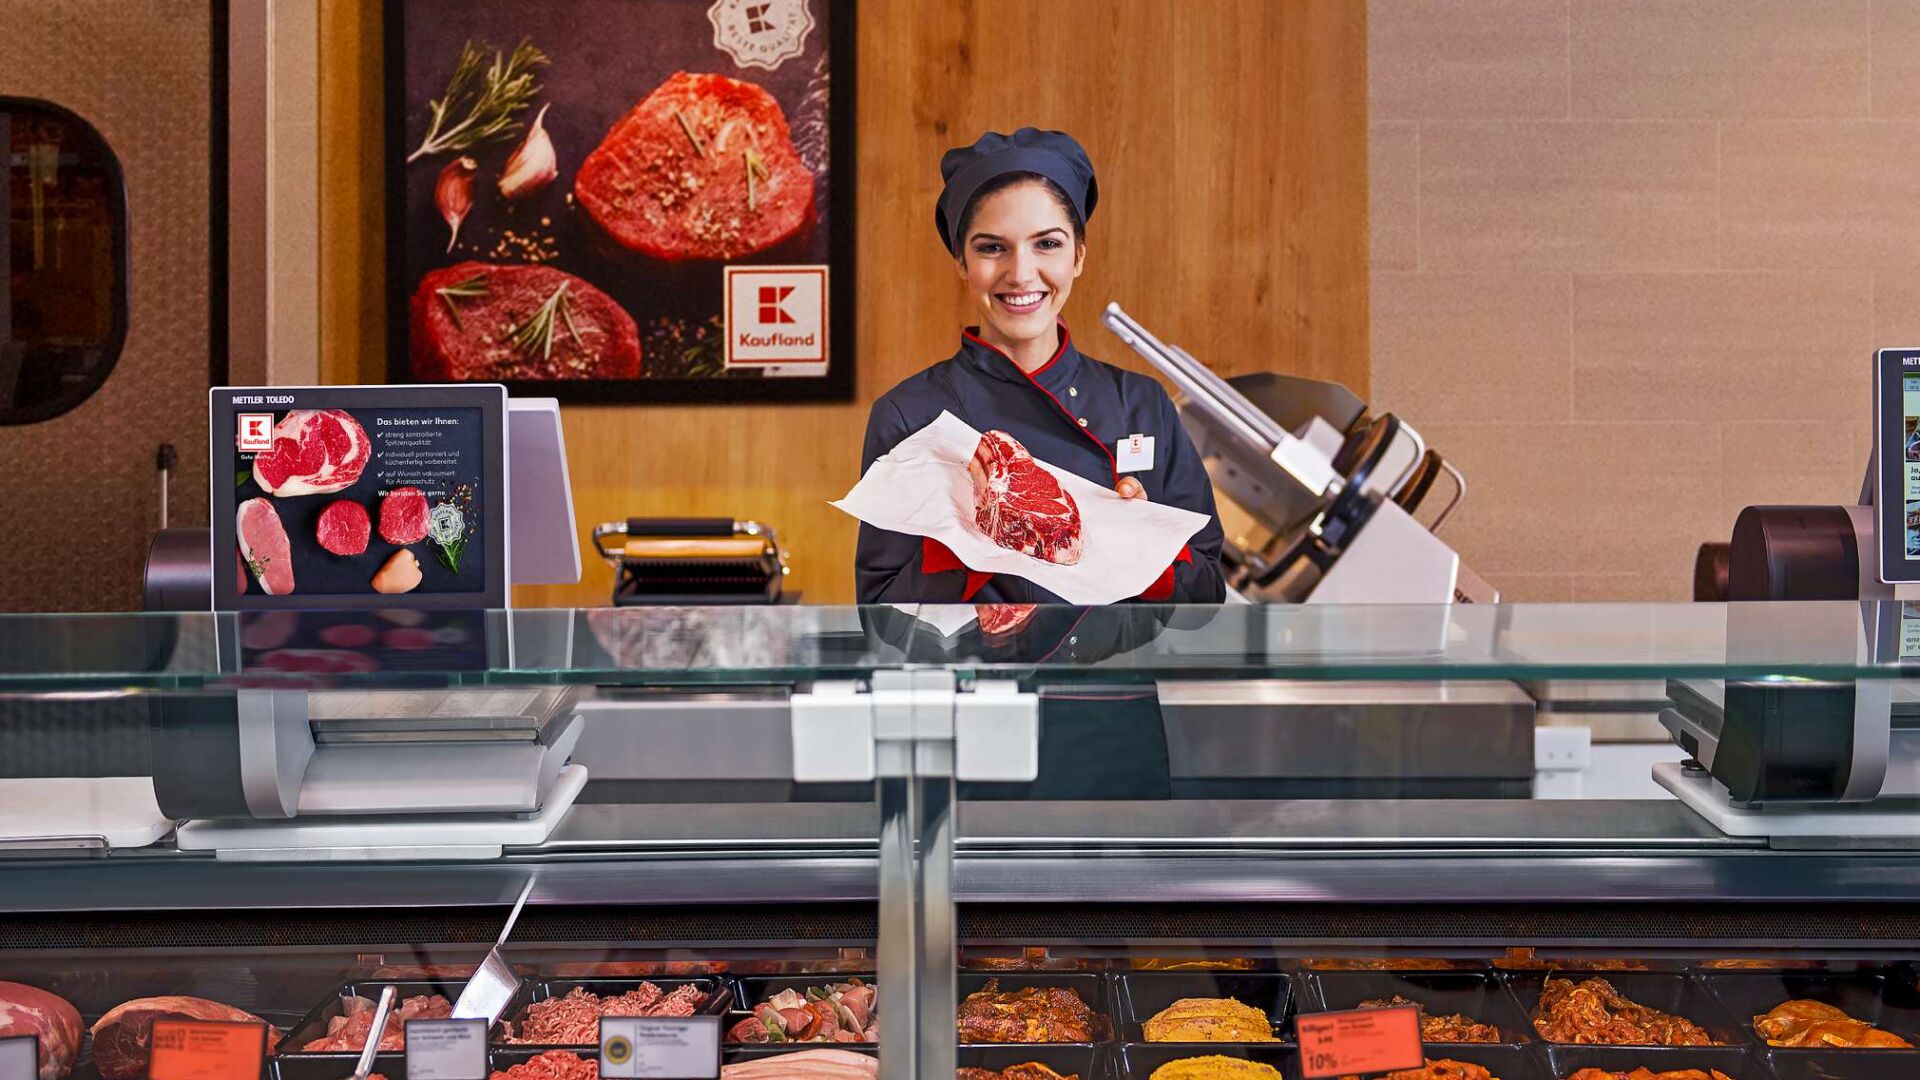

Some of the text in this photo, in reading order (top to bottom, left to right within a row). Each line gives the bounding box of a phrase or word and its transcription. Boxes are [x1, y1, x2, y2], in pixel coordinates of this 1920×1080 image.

[739, 333, 815, 347] Kaufland
[232, 395, 295, 404] METTLER TOLEDO
[377, 417, 459, 426] Das bieten wir Ihnen:
[415, 451, 447, 459] portioniert
[422, 470, 455, 478] vakuumiert
[427, 490, 447, 498] gerne.
[1308, 1051, 1338, 1071] 10%
